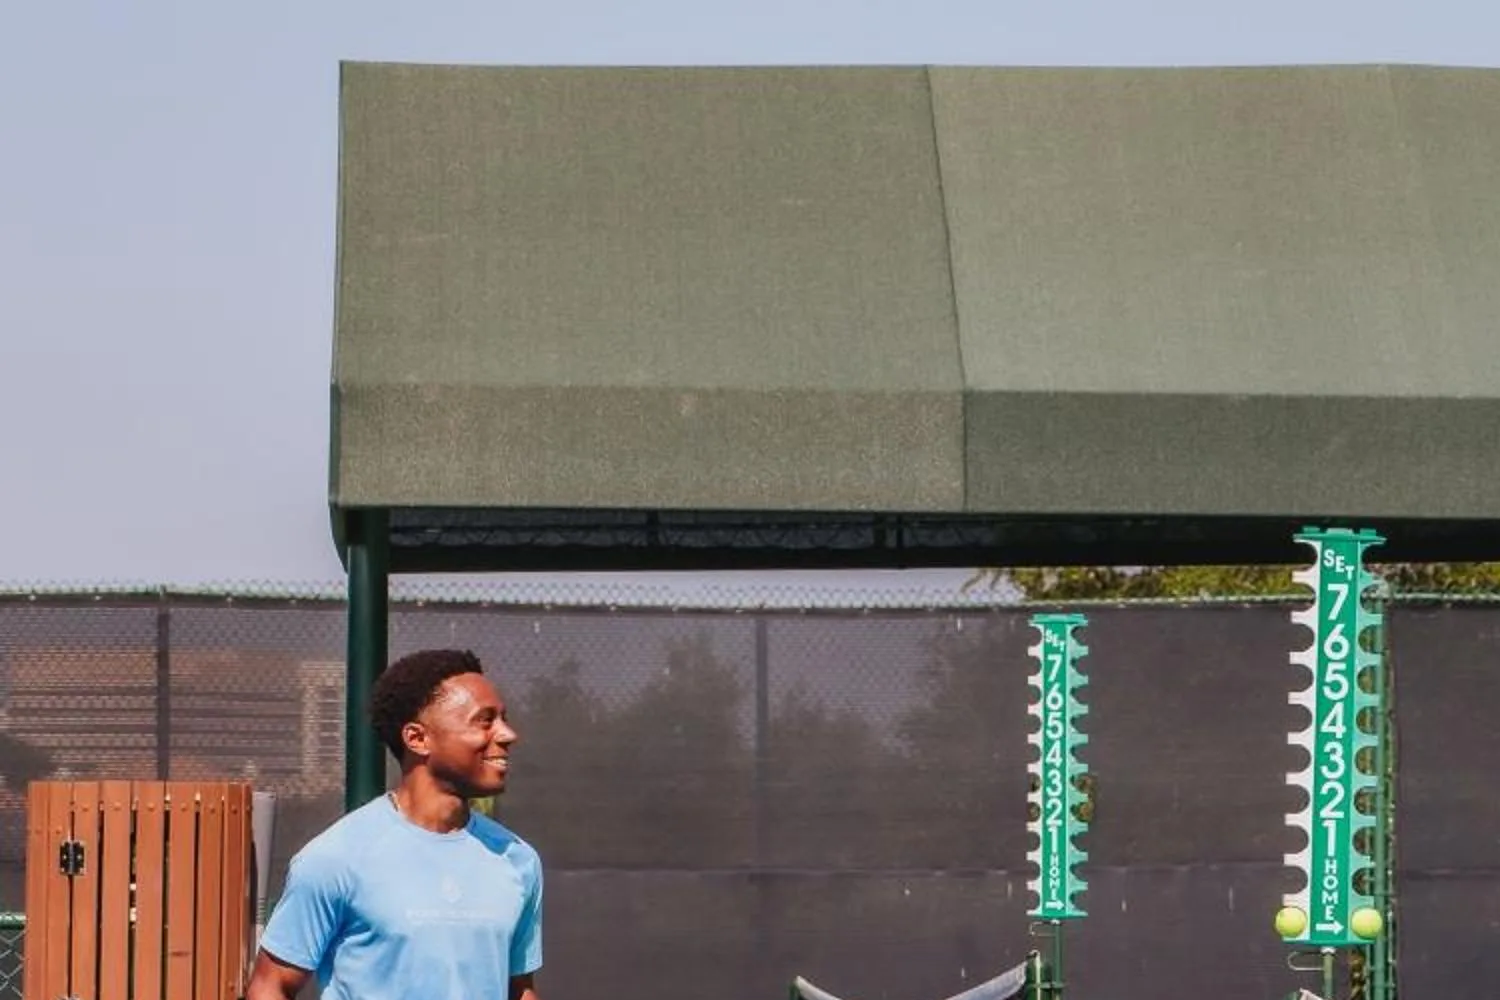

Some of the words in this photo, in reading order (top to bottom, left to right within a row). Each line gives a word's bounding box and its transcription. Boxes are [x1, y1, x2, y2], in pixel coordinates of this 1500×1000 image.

[1323, 549, 1355, 580] SET
[1327, 583, 1349, 620] 7
[1323, 623, 1349, 661] 6
[1047, 654, 1062, 682] 7
[1322, 662, 1349, 701] 5
[1046, 683, 1063, 711] 6
[1046, 711, 1064, 740] 5
[1320, 702, 1347, 739] 4
[1045, 740, 1063, 768] 4
[1320, 741, 1346, 780] 3
[1046, 769, 1063, 797] 3
[1319, 780, 1345, 819] 2
[1046, 797, 1063, 827] 2
[1049, 827, 1059, 853] 1
[1322, 819, 1337, 857] 1
[1321, 859, 1339, 921] HOME
